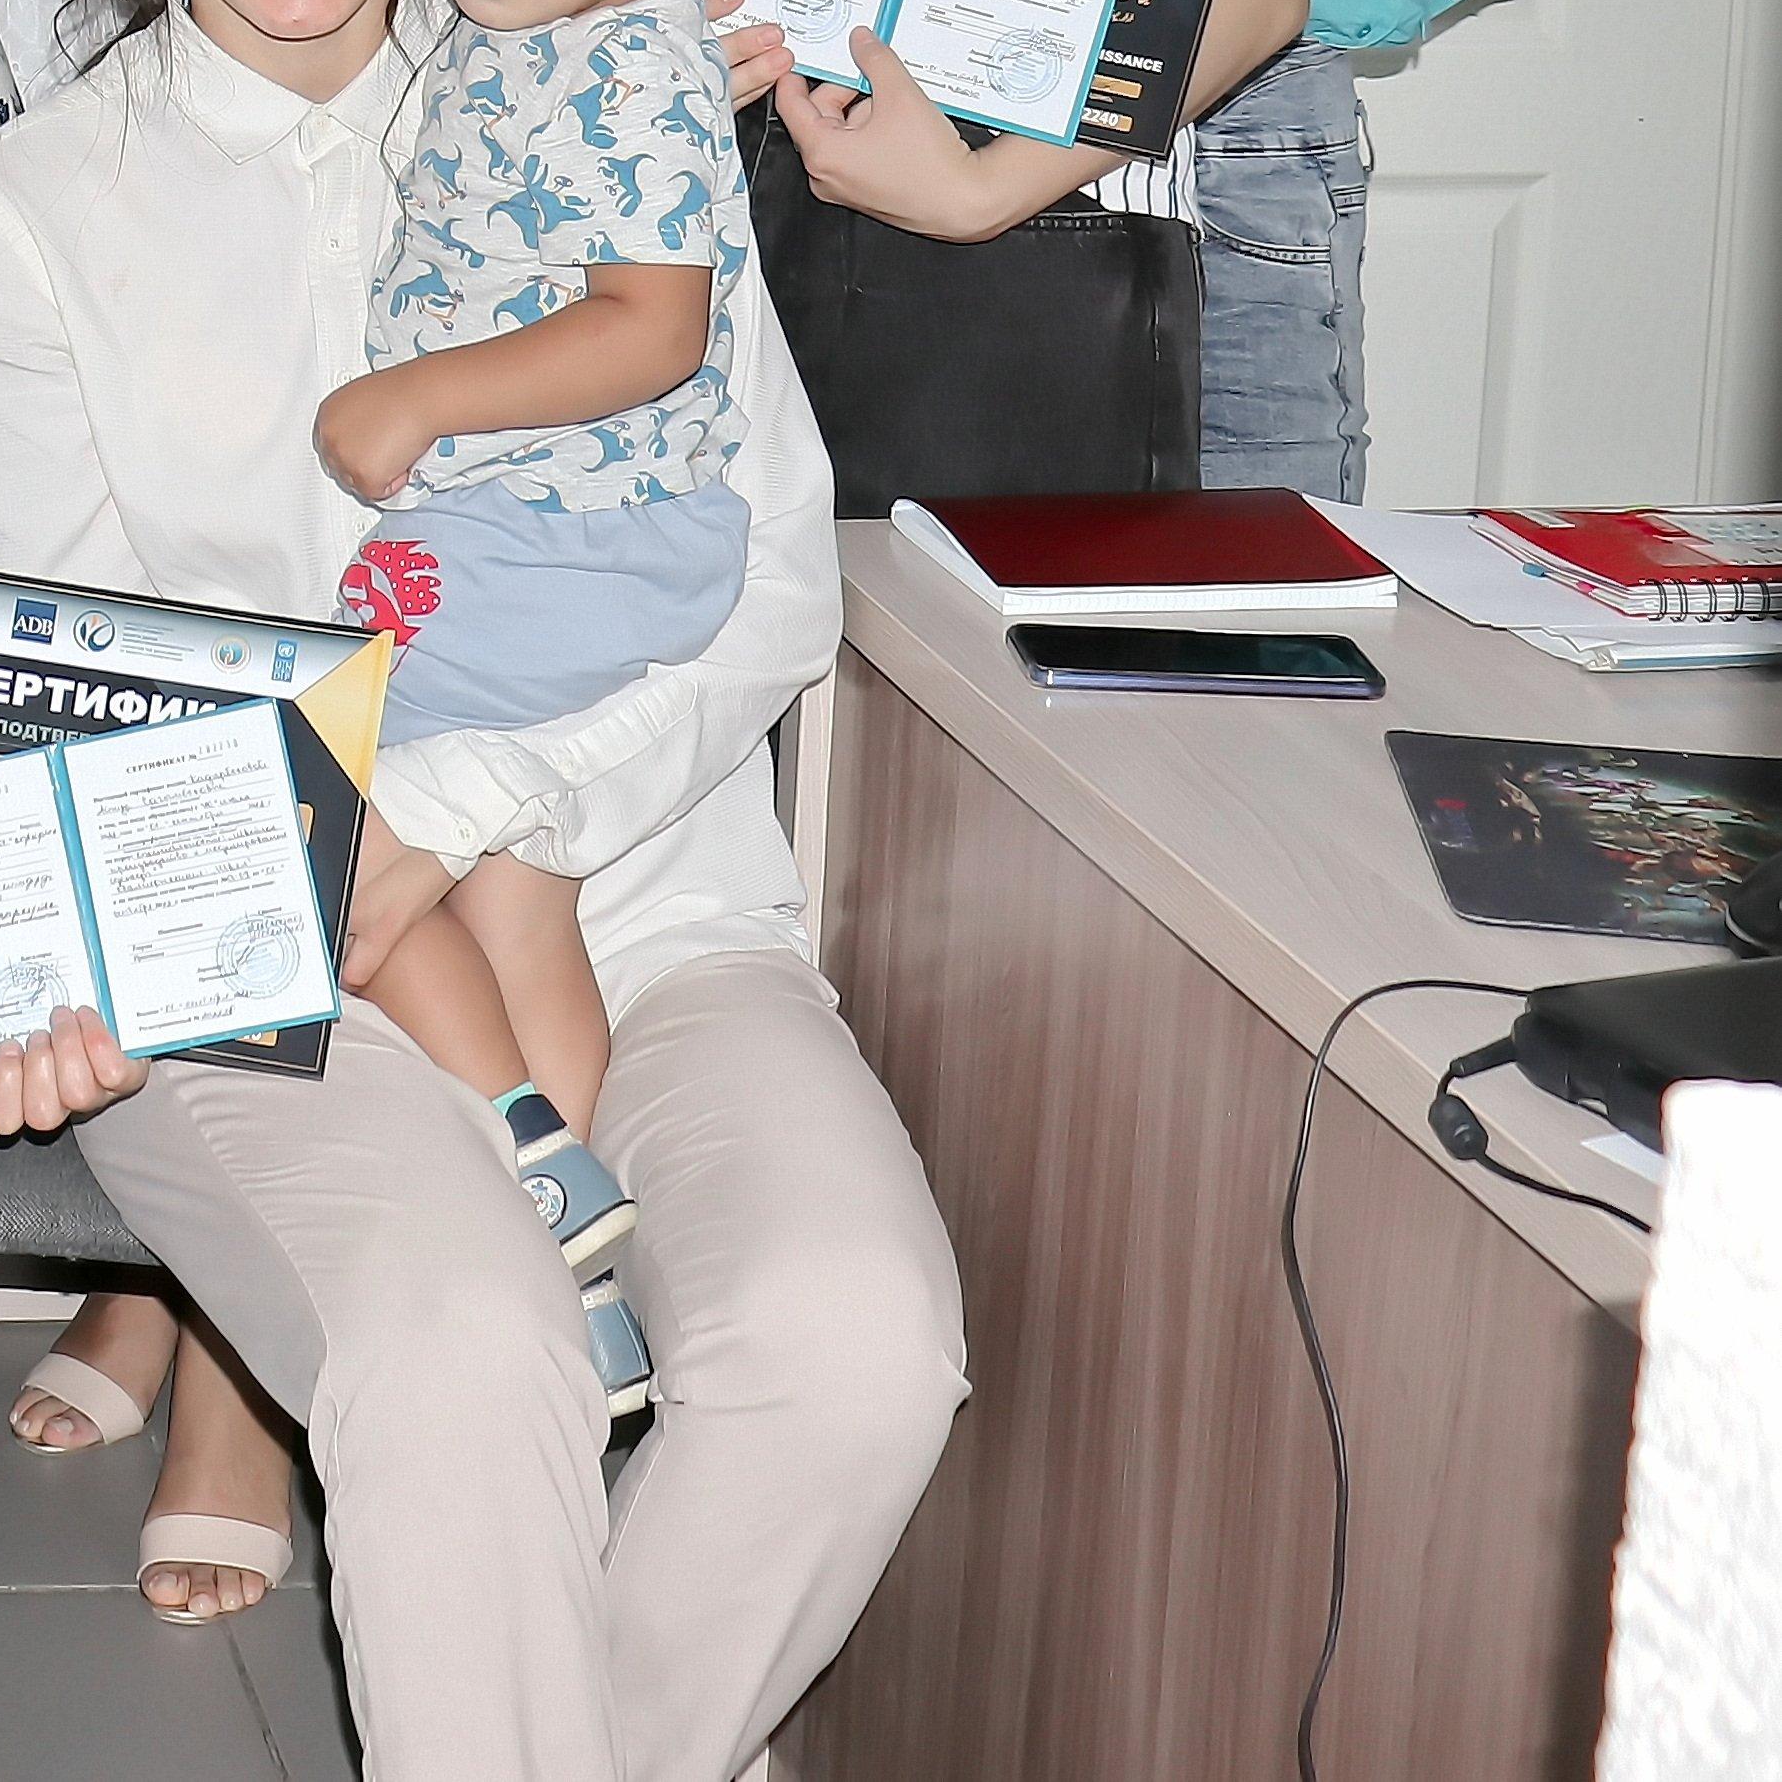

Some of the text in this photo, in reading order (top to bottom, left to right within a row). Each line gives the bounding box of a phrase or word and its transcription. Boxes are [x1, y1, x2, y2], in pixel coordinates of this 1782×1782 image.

[1099, 49, 1165, 74] ISSANCE
[1082, 107, 1119, 127] 2240
[13, 614, 55, 638] ADB
